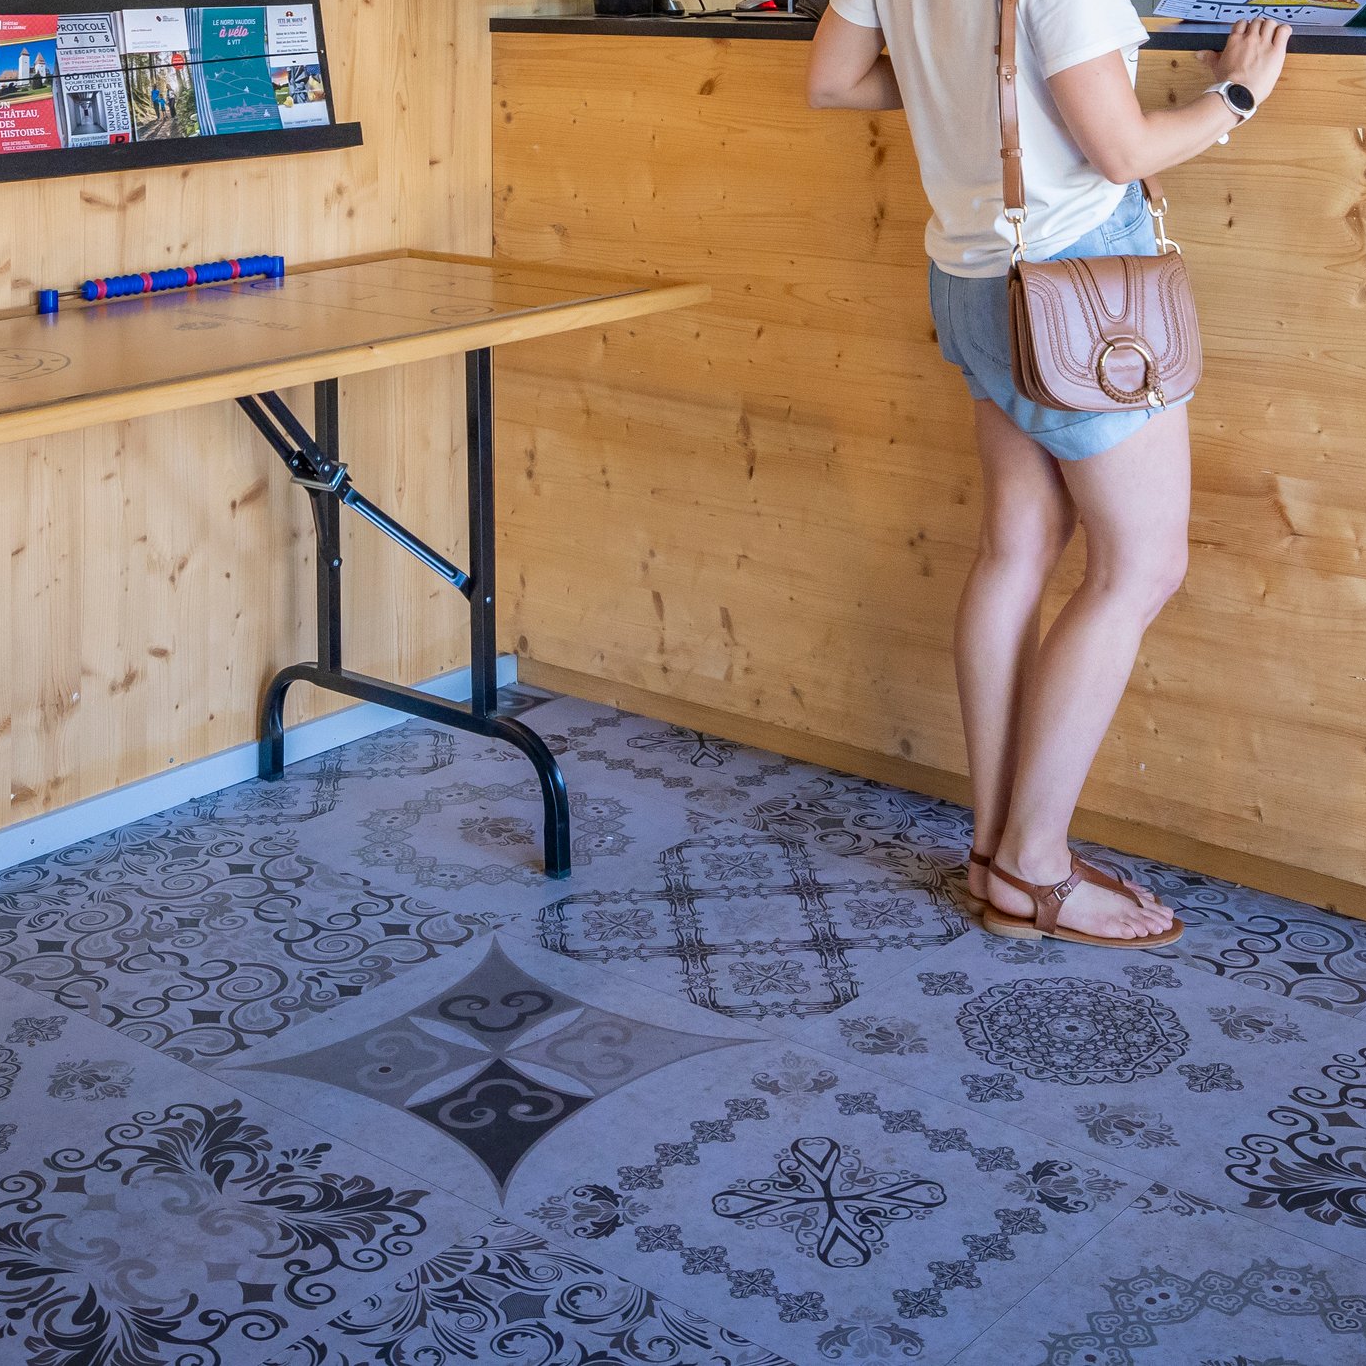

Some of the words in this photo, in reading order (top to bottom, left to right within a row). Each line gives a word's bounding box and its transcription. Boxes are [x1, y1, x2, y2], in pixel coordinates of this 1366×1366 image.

[57, 23, 107, 32] PROTOCOLE
[219, 27, 226, 38] à
[228, 26, 249, 37] vélo
[65, 84, 96, 92] VOTRE
[104, 92, 115, 120] UNIQUE
[0, 120, 15, 129] DES
